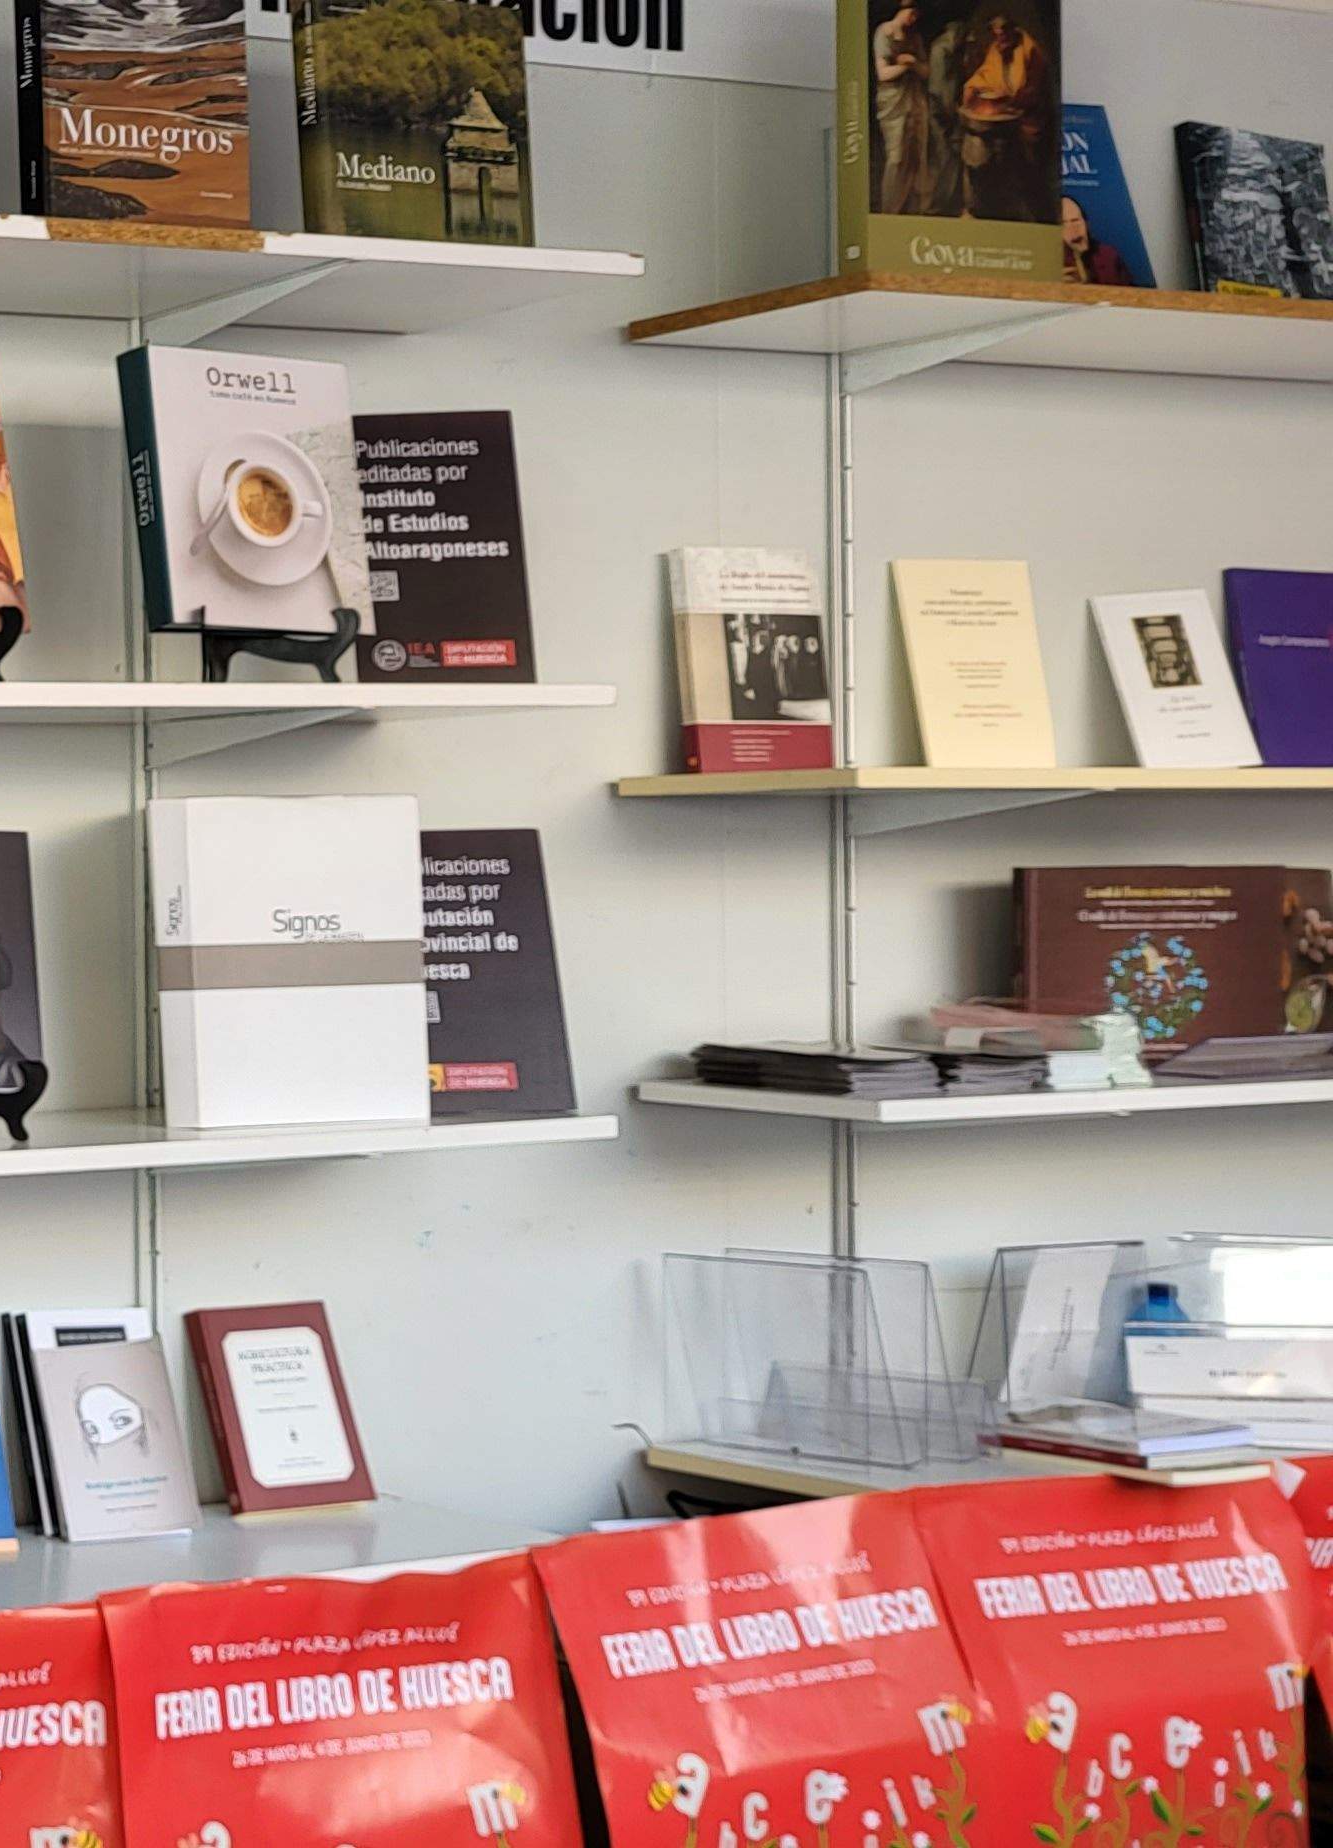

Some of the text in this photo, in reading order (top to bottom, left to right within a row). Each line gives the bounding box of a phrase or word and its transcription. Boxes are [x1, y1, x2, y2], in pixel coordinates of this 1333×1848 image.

[58, 107, 234, 164] Monegros
[335, 151, 436, 185] Mediano
[206, 366, 296, 394] Orwell
[355, 438, 480, 459] Publicaciones
[358, 464, 469, 484] editadas por
[387, 512, 470, 533] Estudios
[366, 540, 510, 562] Altoaragoneses
[422, 856, 510, 876] licaciones
[422, 883, 501, 904] adas por
[272, 908, 341, 939] Signos
[422, 906, 495, 927] utación
[421, 931, 519, 952] ovincial de
[425, 962, 471, 980] esca
[973, 1575, 1048, 1619] FERIA
[1039, 1571, 1091, 1613] DEL
[1083, 1566, 1158, 1610] LIBRO
[1150, 1562, 1192, 1604] DE
[1183, 1552, 1290, 1601] HUESCA
[600, 1586, 939, 1680] FERIA DEL LIBRO DE HUESCA
[155, 1656, 515, 1740] FERIA DEL LIBRO DE HUESCA
